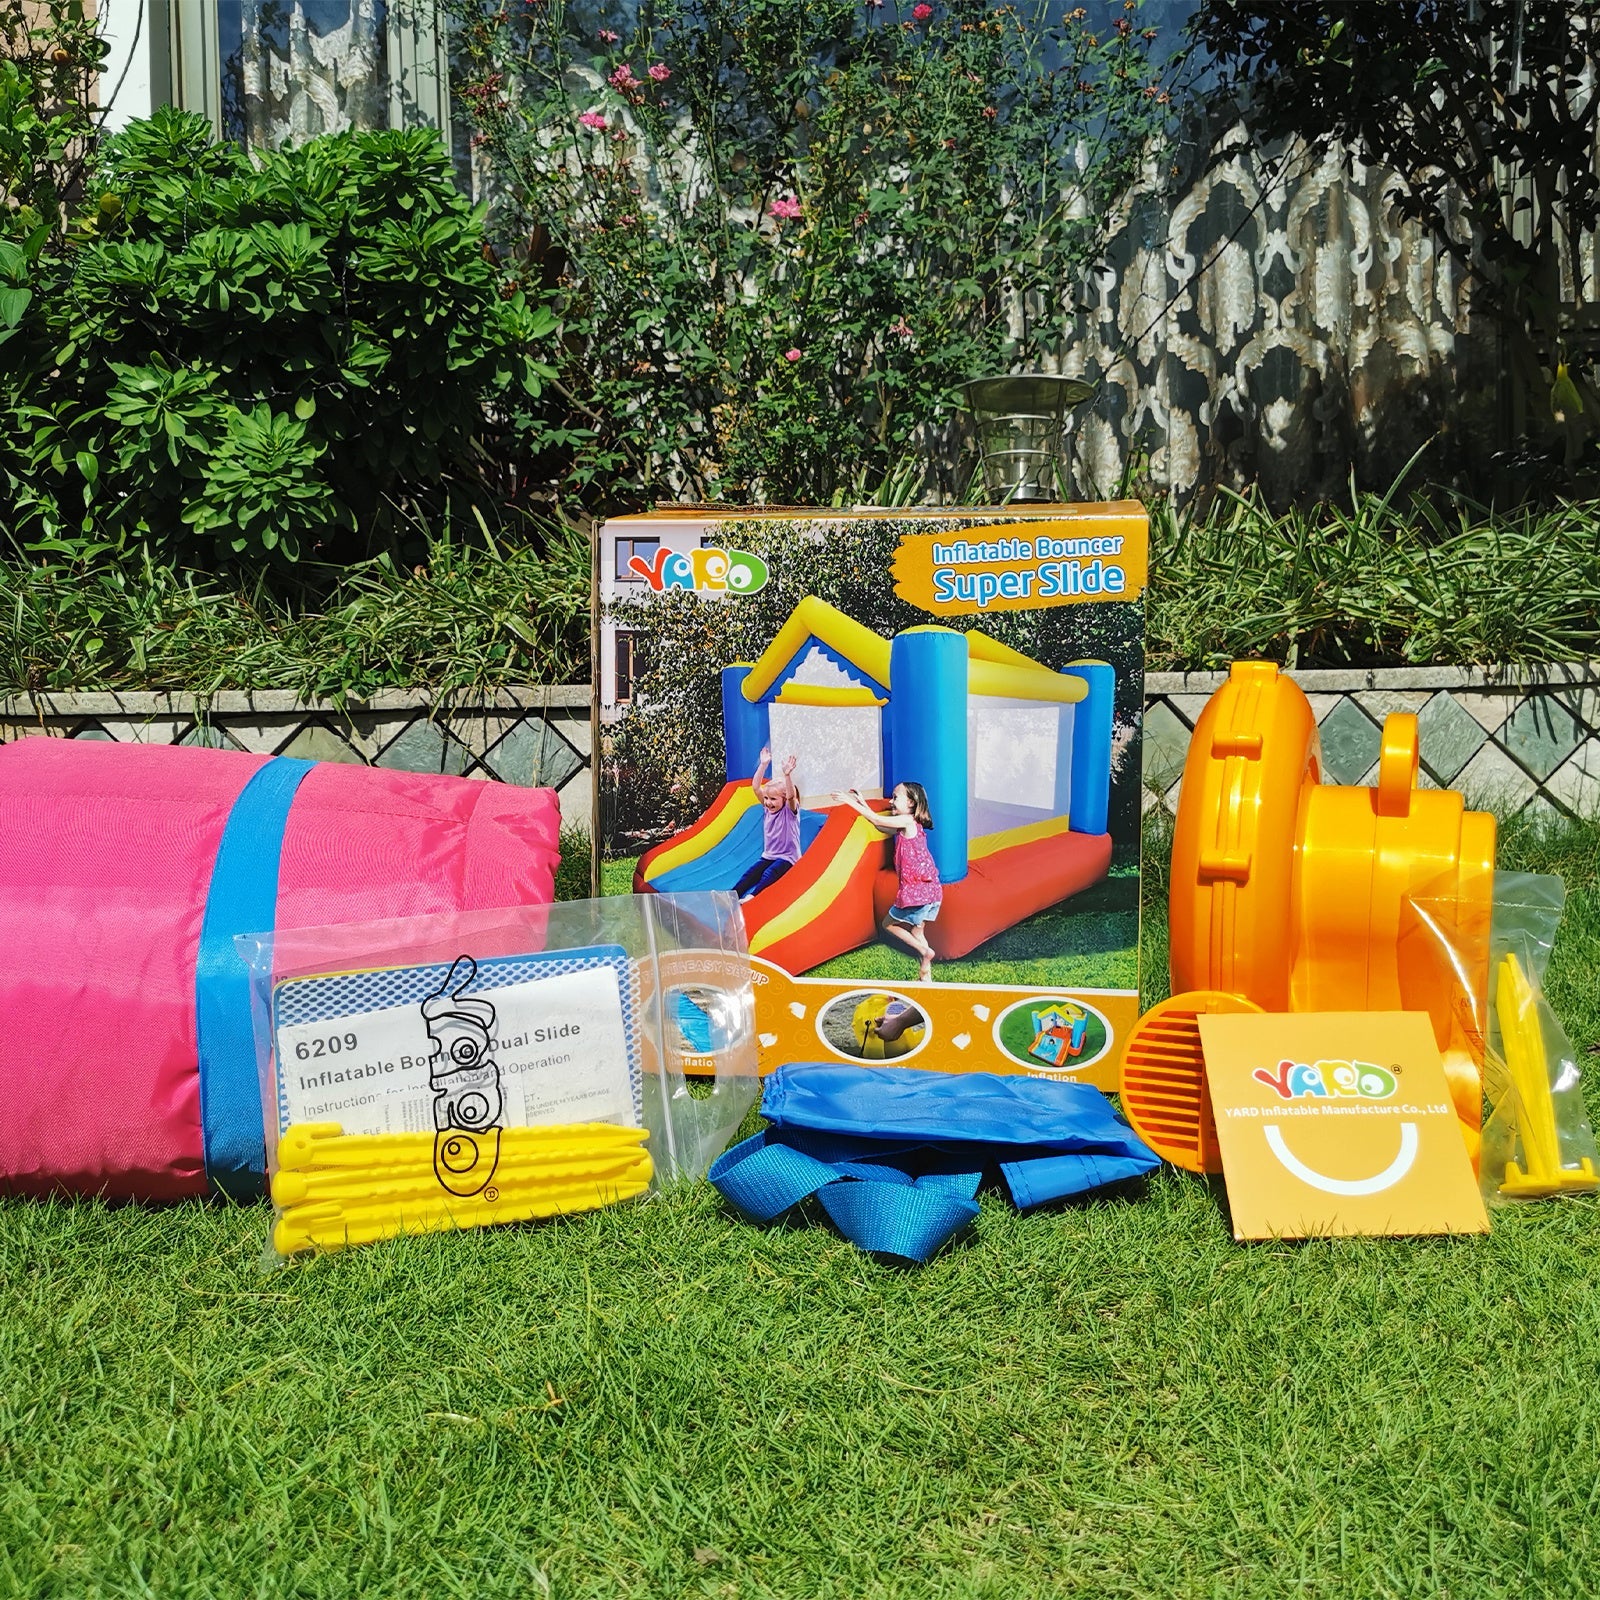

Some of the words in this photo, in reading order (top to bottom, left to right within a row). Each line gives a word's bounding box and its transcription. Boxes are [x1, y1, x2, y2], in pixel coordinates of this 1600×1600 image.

[932, 537, 1033, 565] Inflatable
[1035, 535, 1125, 560] Bouncer
[627, 547, 769, 595] YARD
[932, 568, 1036, 608] Super
[1037, 559, 1126, 597] Slide
[296, 1033, 358, 1060] 6209
[300, 1061, 394, 1090] Inflatable
[488, 1032, 529, 1052] Dual
[534, 1023, 581, 1042] Slide
[509, 1053, 571, 1073] Operation
[1252, 1059, 1398, 1100] YARD
[1224, 1107, 1259, 1117] YARD
[1261, 1105, 1319, 1116] Inflatable
[1321, 1104, 1399, 1115] Manufacture
[1401, 1104, 1426, 1115] Co.,
[1428, 1103, 1448, 1114] Ltd
